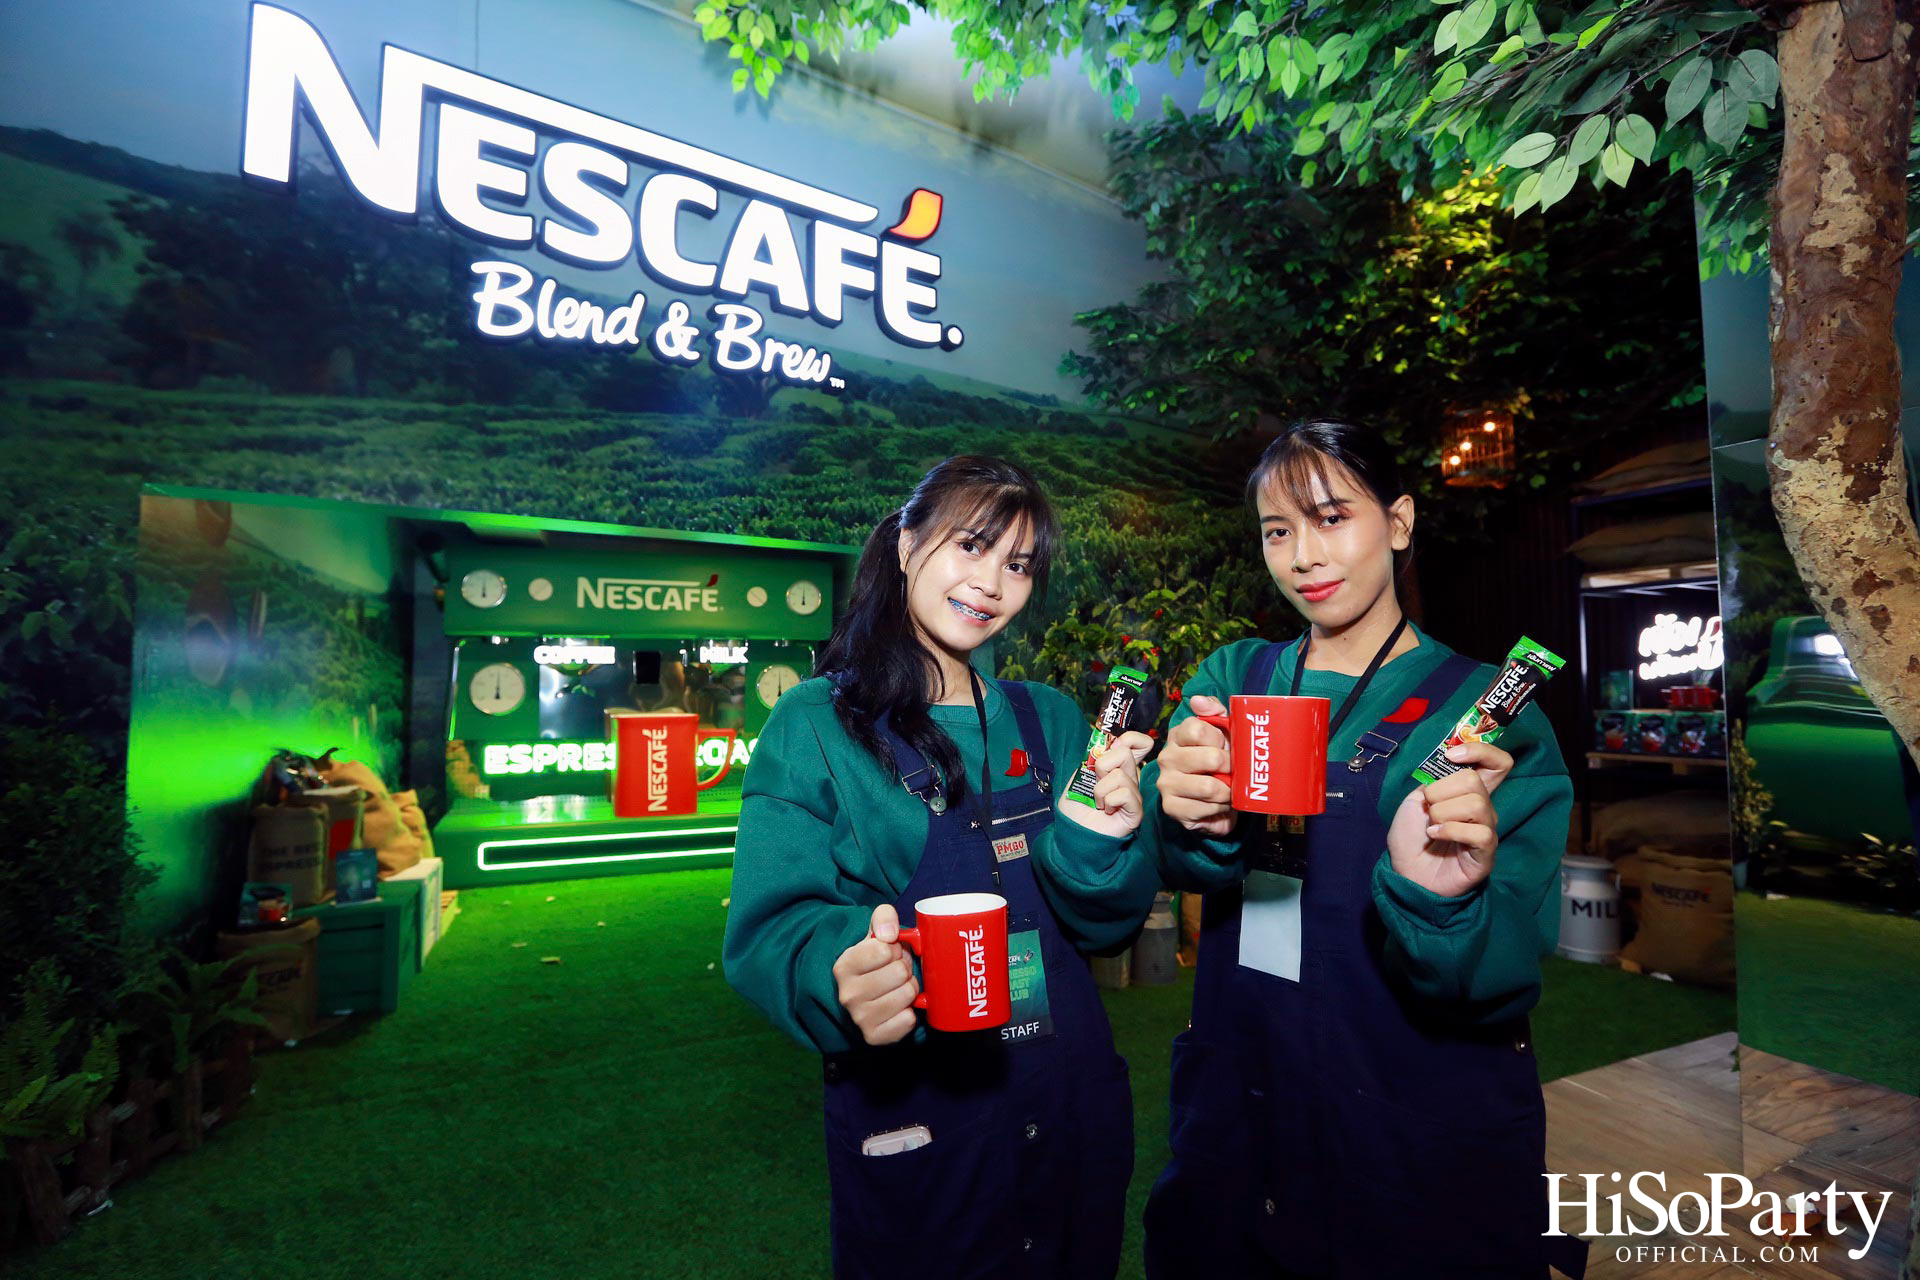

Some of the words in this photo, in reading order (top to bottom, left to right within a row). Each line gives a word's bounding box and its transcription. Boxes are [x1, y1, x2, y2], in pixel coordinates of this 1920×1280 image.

[470, 261, 645, 337] Blend
[656, 301, 700, 360] &
[533, 645, 615, 664] COFFEE
[699, 646, 748, 663] MILK
[997, 839, 1025, 855] PMGO
[1001, 1021, 1040, 1040] STAFF
